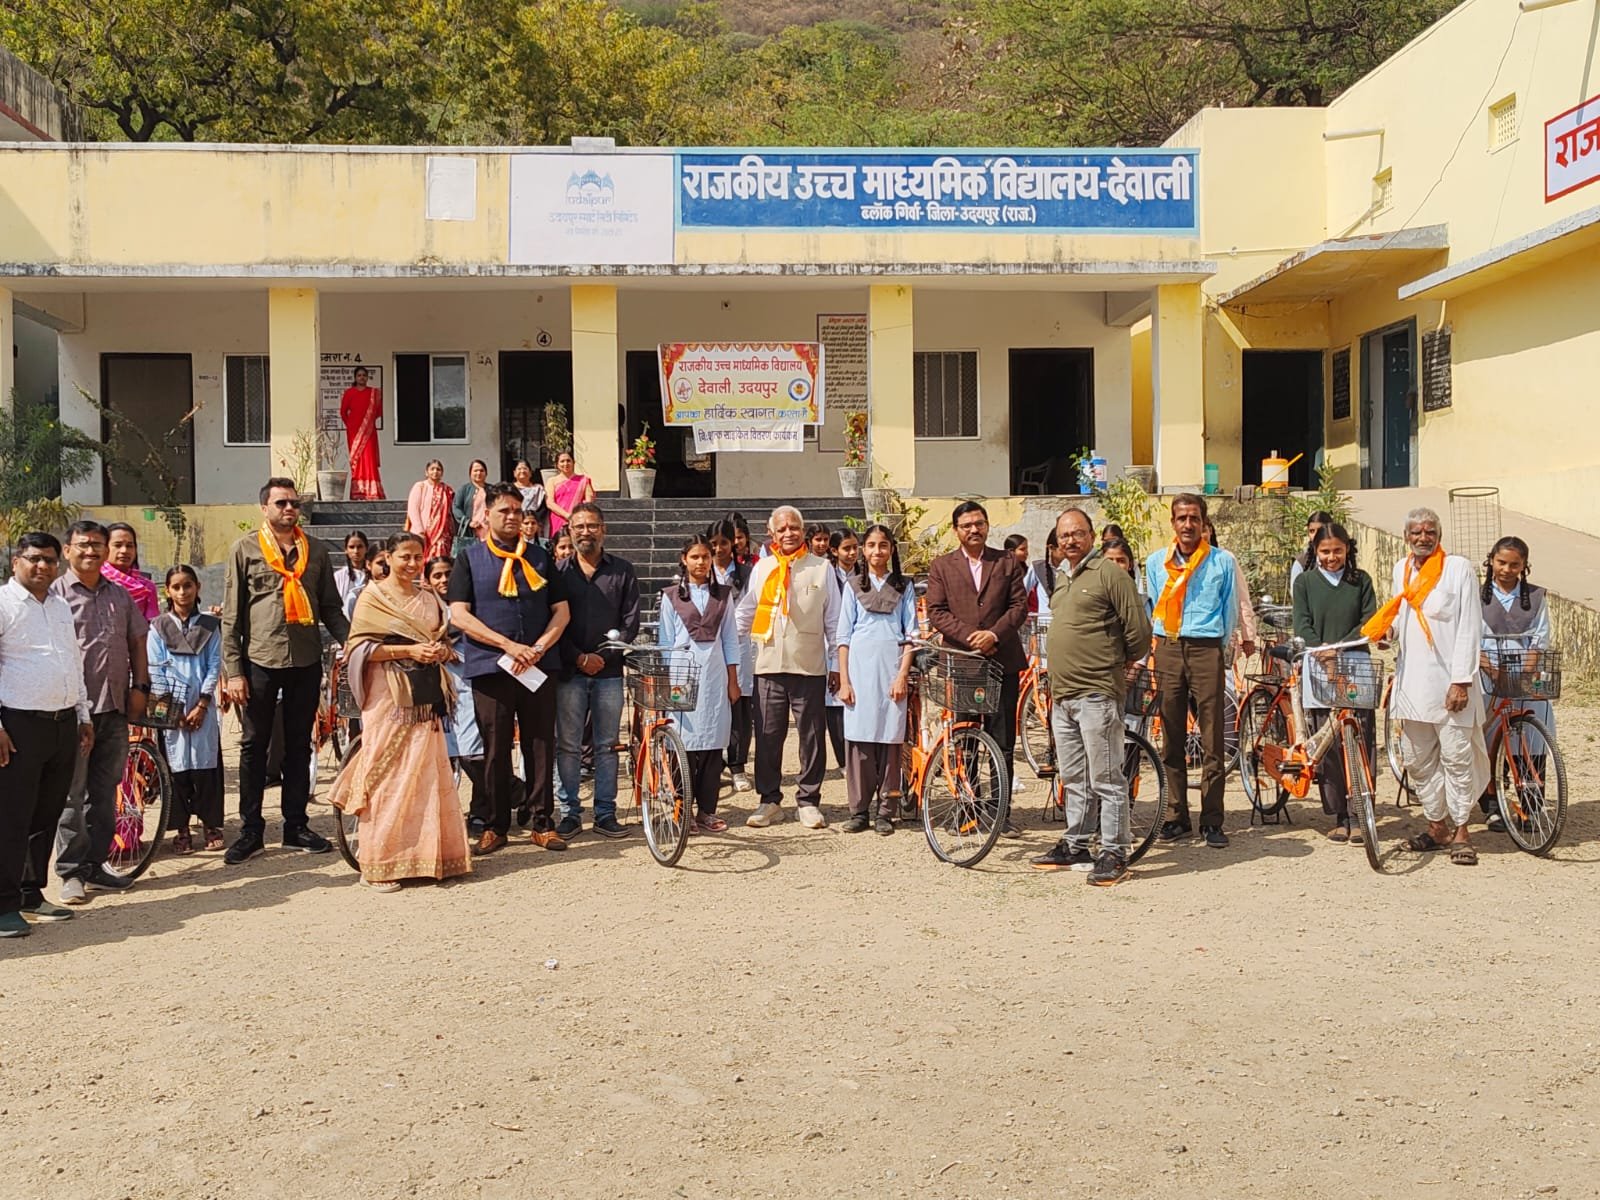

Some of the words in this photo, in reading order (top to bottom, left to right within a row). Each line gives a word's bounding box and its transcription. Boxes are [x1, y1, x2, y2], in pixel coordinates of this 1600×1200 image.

[683, 155, 792, 200] राजकीय
[794, 165, 857, 200] उच्च
[862, 156, 989, 201] माध्यमिक
[860, 202, 893, 220] ब्लॉक
[354, 353, 362, 363] 4
[679, 356, 713, 372] राजकीय
[714, 360, 731, 372] उच्च
[733, 356, 769, 372] माध्यमिक
[771, 356, 802, 371] विद्यालय
[738, 382, 779, 399] उदयपुर
[704, 403, 737, 419] हार्दिक
[740, 408, 776, 420] स्वागत
[750, 427, 772, 441] वितरण
